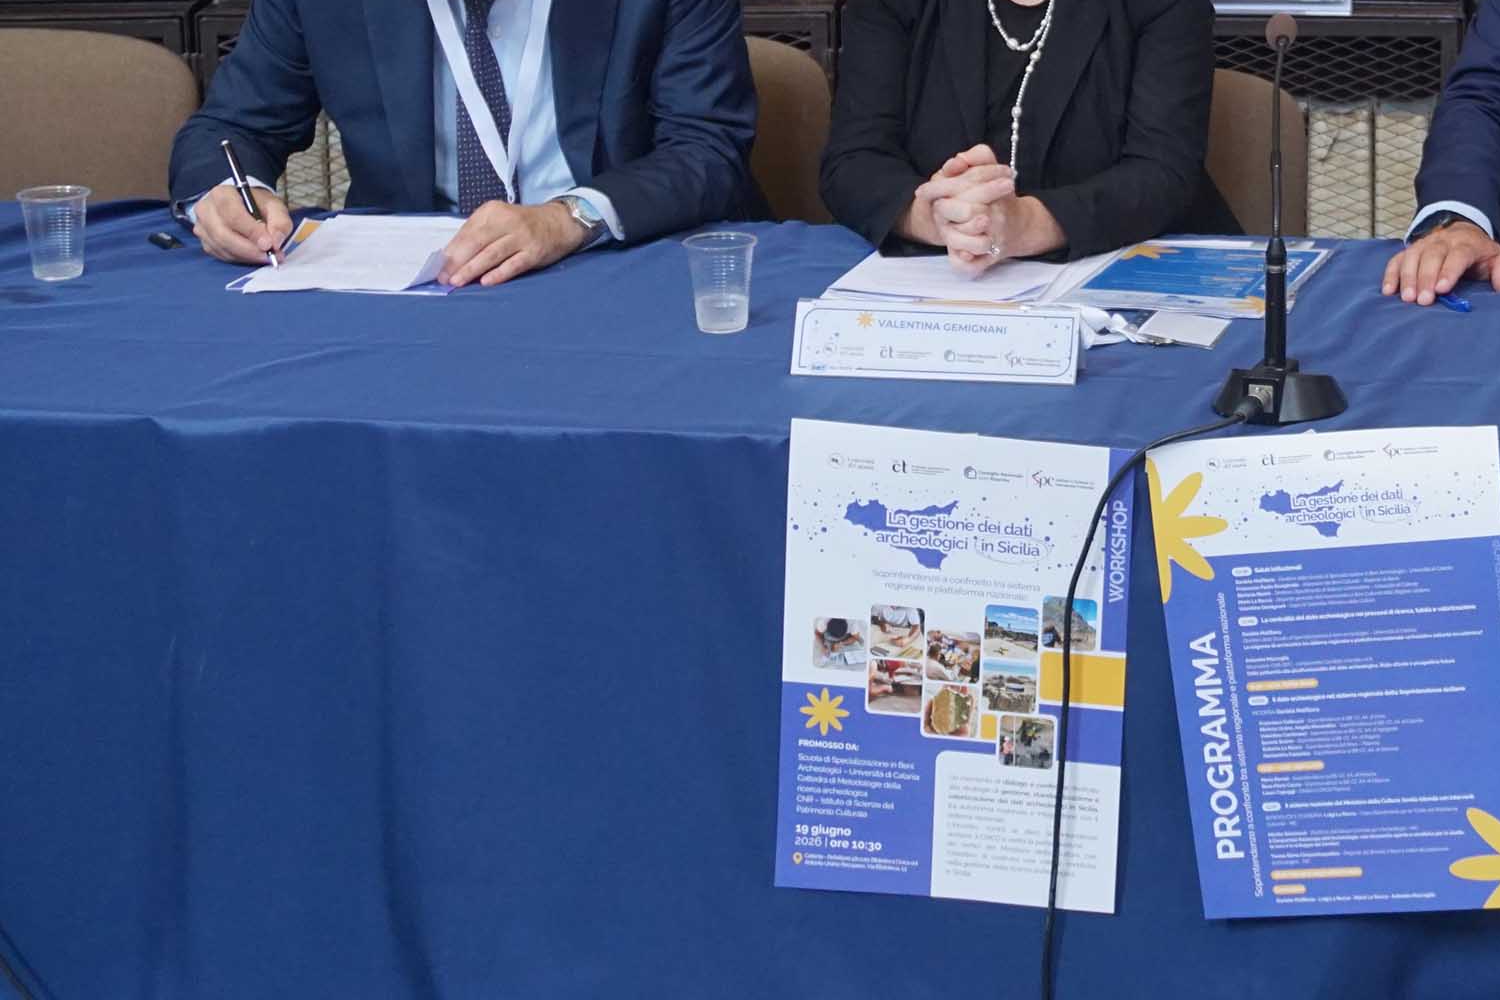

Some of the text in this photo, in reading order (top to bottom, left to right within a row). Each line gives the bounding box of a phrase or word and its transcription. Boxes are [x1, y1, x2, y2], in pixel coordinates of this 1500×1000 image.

[878, 319, 1007, 335] VALENTINA GEMIGNANI
[1292, 488, 1403, 509] La gestione dei dati
[1285, 503, 1411, 523] archeologici in Sicilia
[889, 511, 1033, 537] La gestione dei dati
[876, 531, 1040, 557] archeologici in Sicilia
[1108, 499, 1128, 603] WORKSHOP
[798, 739, 845, 750] PROMOSSO
[1189, 631, 1244, 860] PROGRAMMA
[795, 823, 852, 838] 19 giugno
[794, 837, 822, 847] 2026
[830, 839, 850, 849] ore
[852, 840, 883, 852] 10:30
